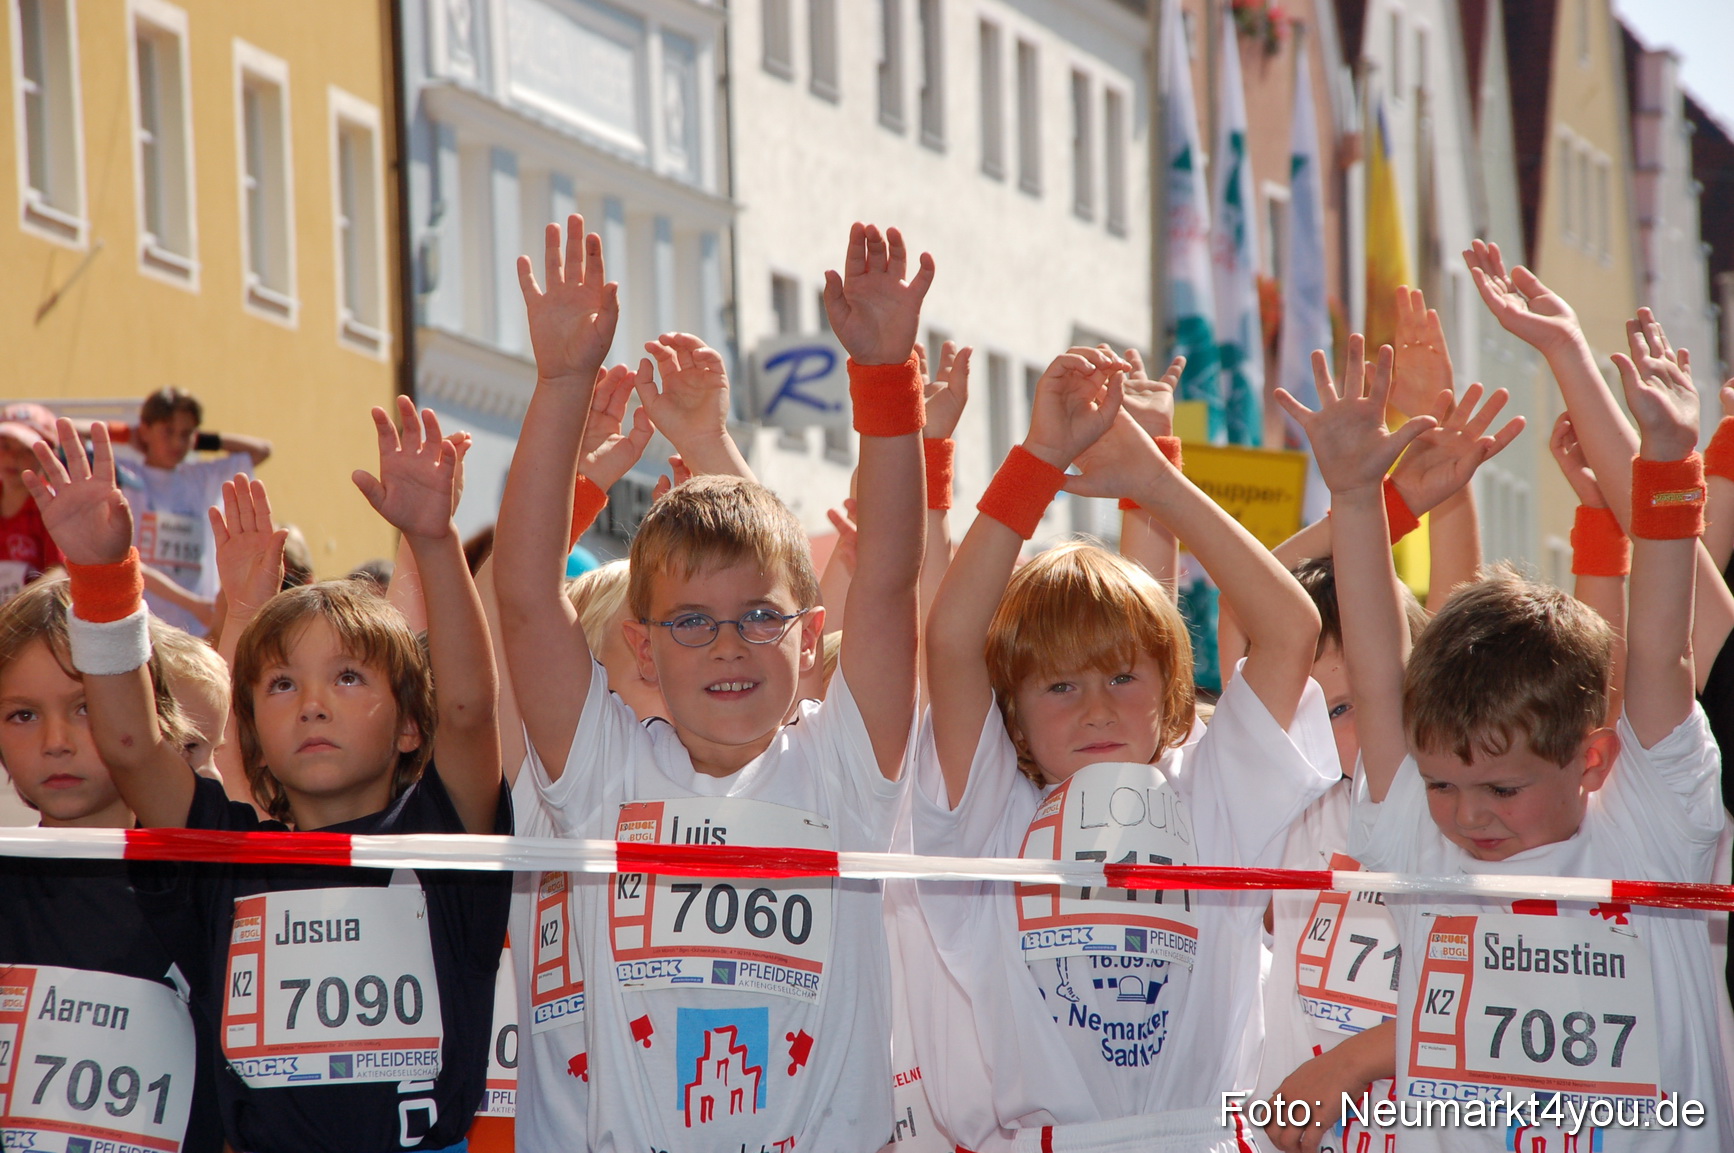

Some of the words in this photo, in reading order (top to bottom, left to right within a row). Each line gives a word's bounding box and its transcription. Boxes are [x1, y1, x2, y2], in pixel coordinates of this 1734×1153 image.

[617, 873, 642, 900] K2
[275, 909, 361, 946] Josua
[670, 882, 813, 945] 7060
[541, 919, 559, 949] K2
[1021, 926, 1094, 951] BOCK
[1308, 917, 1332, 942] K2
[1484, 932, 1626, 979] Sebastian
[232, 970, 253, 998] K2
[616, 959, 682, 981] BOCK
[739, 962, 820, 991] PFLEIDERER
[37, 986, 130, 1030] Aaron
[280, 973, 423, 1030] 7090
[1425, 988, 1455, 1016] K2
[1484, 1006, 1636, 1068] 7087
[356, 1050, 439, 1068] PFLEIDERER
[31, 1054, 172, 1125] 7091
[492, 1090, 517, 1105] PFL
[1408, 1079, 1503, 1104] BOCK
